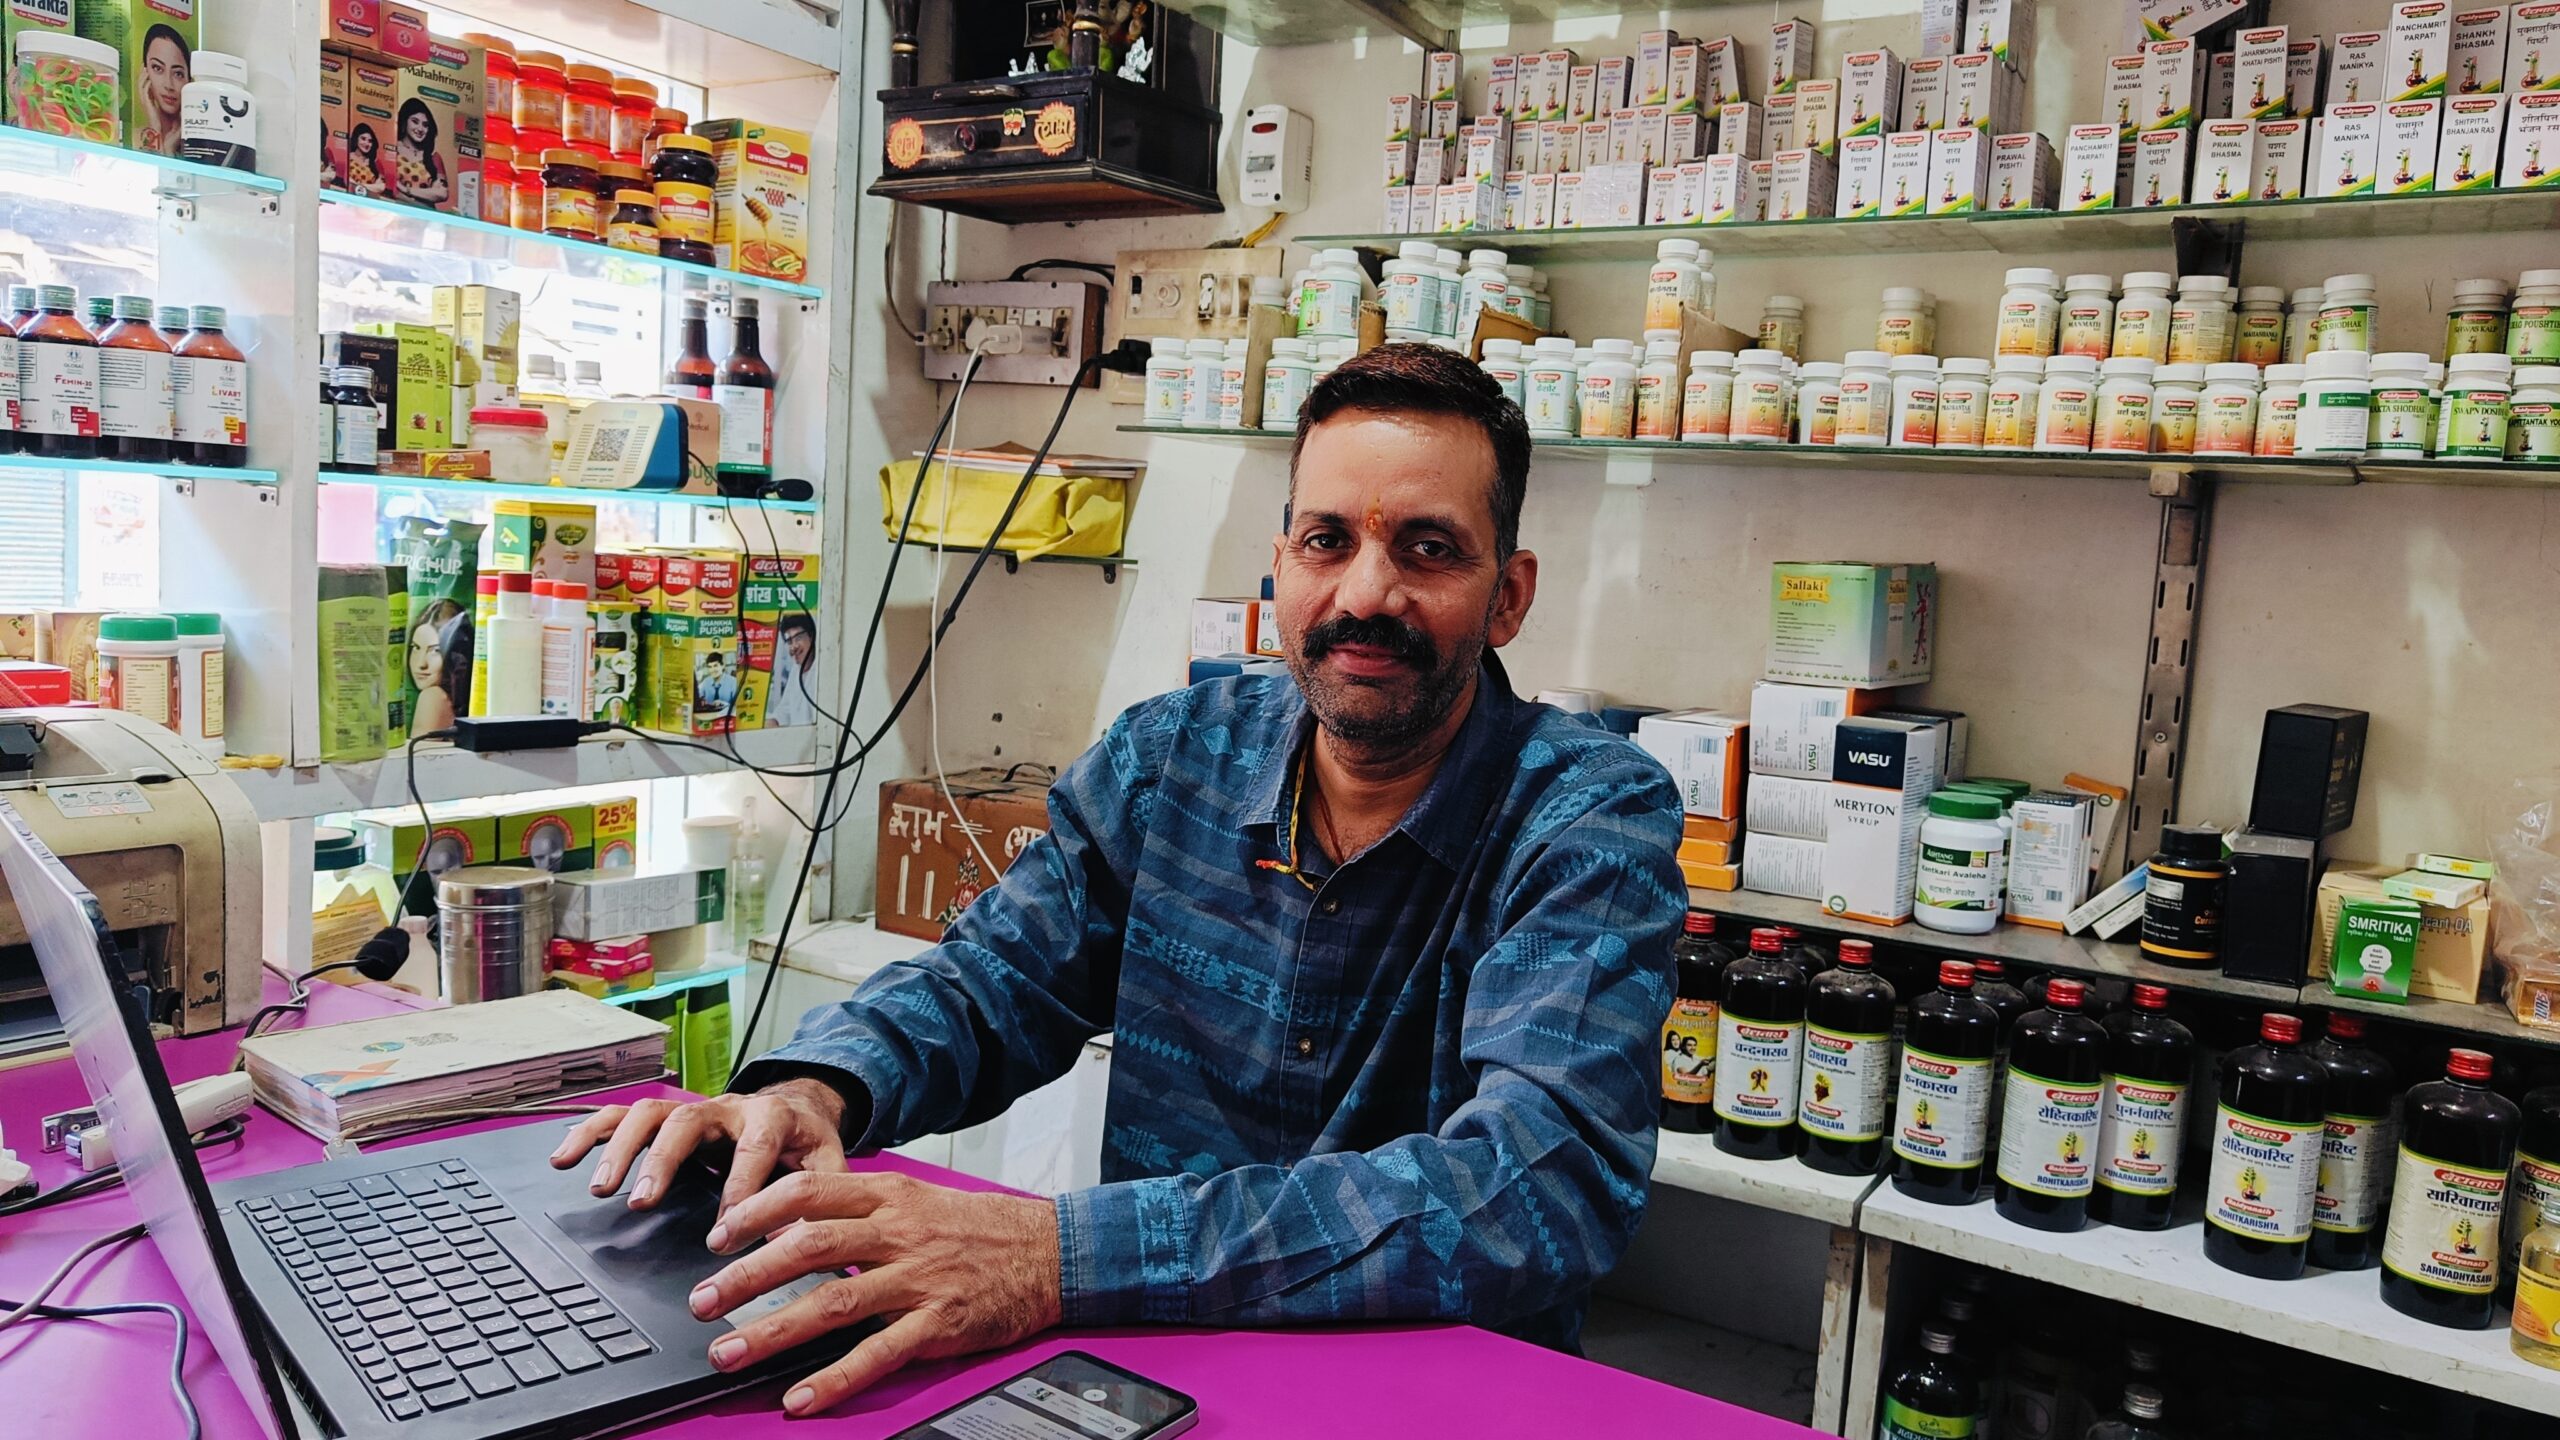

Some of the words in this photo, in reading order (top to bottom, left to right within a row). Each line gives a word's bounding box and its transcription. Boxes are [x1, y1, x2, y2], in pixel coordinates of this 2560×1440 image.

[2402, 3, 2444, 15] Baidyanath
[2456, 12, 2500, 22] Baidyanath
[2395, 20, 2447, 32] PANCHAMRIT
[2245, 30, 2284, 41] Baidyanath
[2341, 34, 2379, 45] Baidyanath
[2403, 32, 2437, 41] PARPATI
[2455, 29, 2496, 40] SHANKH
[2454, 39, 2496, 50] BHASMA
[430, 45, 467, 62] dyanath
[2240, 47, 2285, 58] JAHARMOHARA
[2349, 52, 2367, 60] RAS
[2241, 58, 2263, 67] KHATAI
[2263, 57, 2284, 65] PISHTI
[2338, 61, 2374, 71] MANIKYA
[404, 64, 474, 92] Mahabhringraj
[2117, 73, 2141, 81] VANGA
[1910, 85, 1938, 93] BHASMA
[2113, 81, 2142, 91] BHASMA
[1802, 104, 1827, 112] BHASMA
[2334, 106, 2374, 117] Baidyanath
[2452, 101, 2496, 111] Baidyanath
[2454, 117, 2489, 126] SHITPITTA
[2211, 124, 2249, 134] Baidyanath
[2343, 123, 2362, 132] RAS
[2446, 126, 2479, 136] BHANJAN
[2480, 126, 2496, 135] RAS
[2333, 132, 2370, 143] MANIKYA
[2070, 143, 2113, 152] PANCHAMRIT
[2212, 141, 2242, 149] PRAWAL
[460, 147, 478, 157] FREE
[2077, 153, 2105, 161] PARPATI
[2210, 150, 2242, 159] BHASMA
[1996, 154, 2026, 163] PRAWAL
[394, 552, 463, 576] TRICHUP
[703, 563, 731, 573] 200ml
[665, 574, 691, 586] Extra
[701, 577, 733, 588] Free!
[1786, 579, 1825, 592] Sallaki
[665, 624, 689, 633] PUSHPI
[699, 626, 734, 635] PUSHPI
[1808, 743, 1817, 772] VASU
[1848, 750, 1890, 767] VASU
[1690, 779, 1699, 807] VASU
[1833, 798, 1896, 817] MERYTON
[598, 804, 636, 827] 25%
[1847, 815, 1880, 827] SYRUP
[889, 803, 949, 854] शुभ
[1952, 869, 1987, 880] Avaleha
[2010, 893, 2034, 902] VASU
[2347, 916, 2414, 937] SMRITIKA
[2454, 917, 2475, 934] OA
[2392, 935, 2412, 943] TABLET
[1735, 1043, 1789, 1058] चन्दनासव
[1807, 1049, 1848, 1068] द्राक्षासव
[1903, 1073, 1959, 1095] कनकासव
[1731, 1105, 1783, 1119] CHANDANASAVA
[2231, 1120, 2287, 1142] वैद्यनाथ
[1900, 1139, 1947, 1159] KANKASAVA
[2222, 1134, 2295, 1164] रोहितकारिष्ट
[2037, 1175, 2089, 1188] ROHITKARISHTA
[2103, 1167, 2168, 1185] PUNARNAVARISHTA
[2441, 1170, 2502, 1191] वैद्यनाथ
[2426, 1187, 2505, 1214] सारिवाद्यास
[2225, 1197, 2273, 1216] Baidyanath
[2218, 1207, 2280, 1232] ROHITKARISHTA
[2435, 1252, 2487, 1269] Baidyanath
